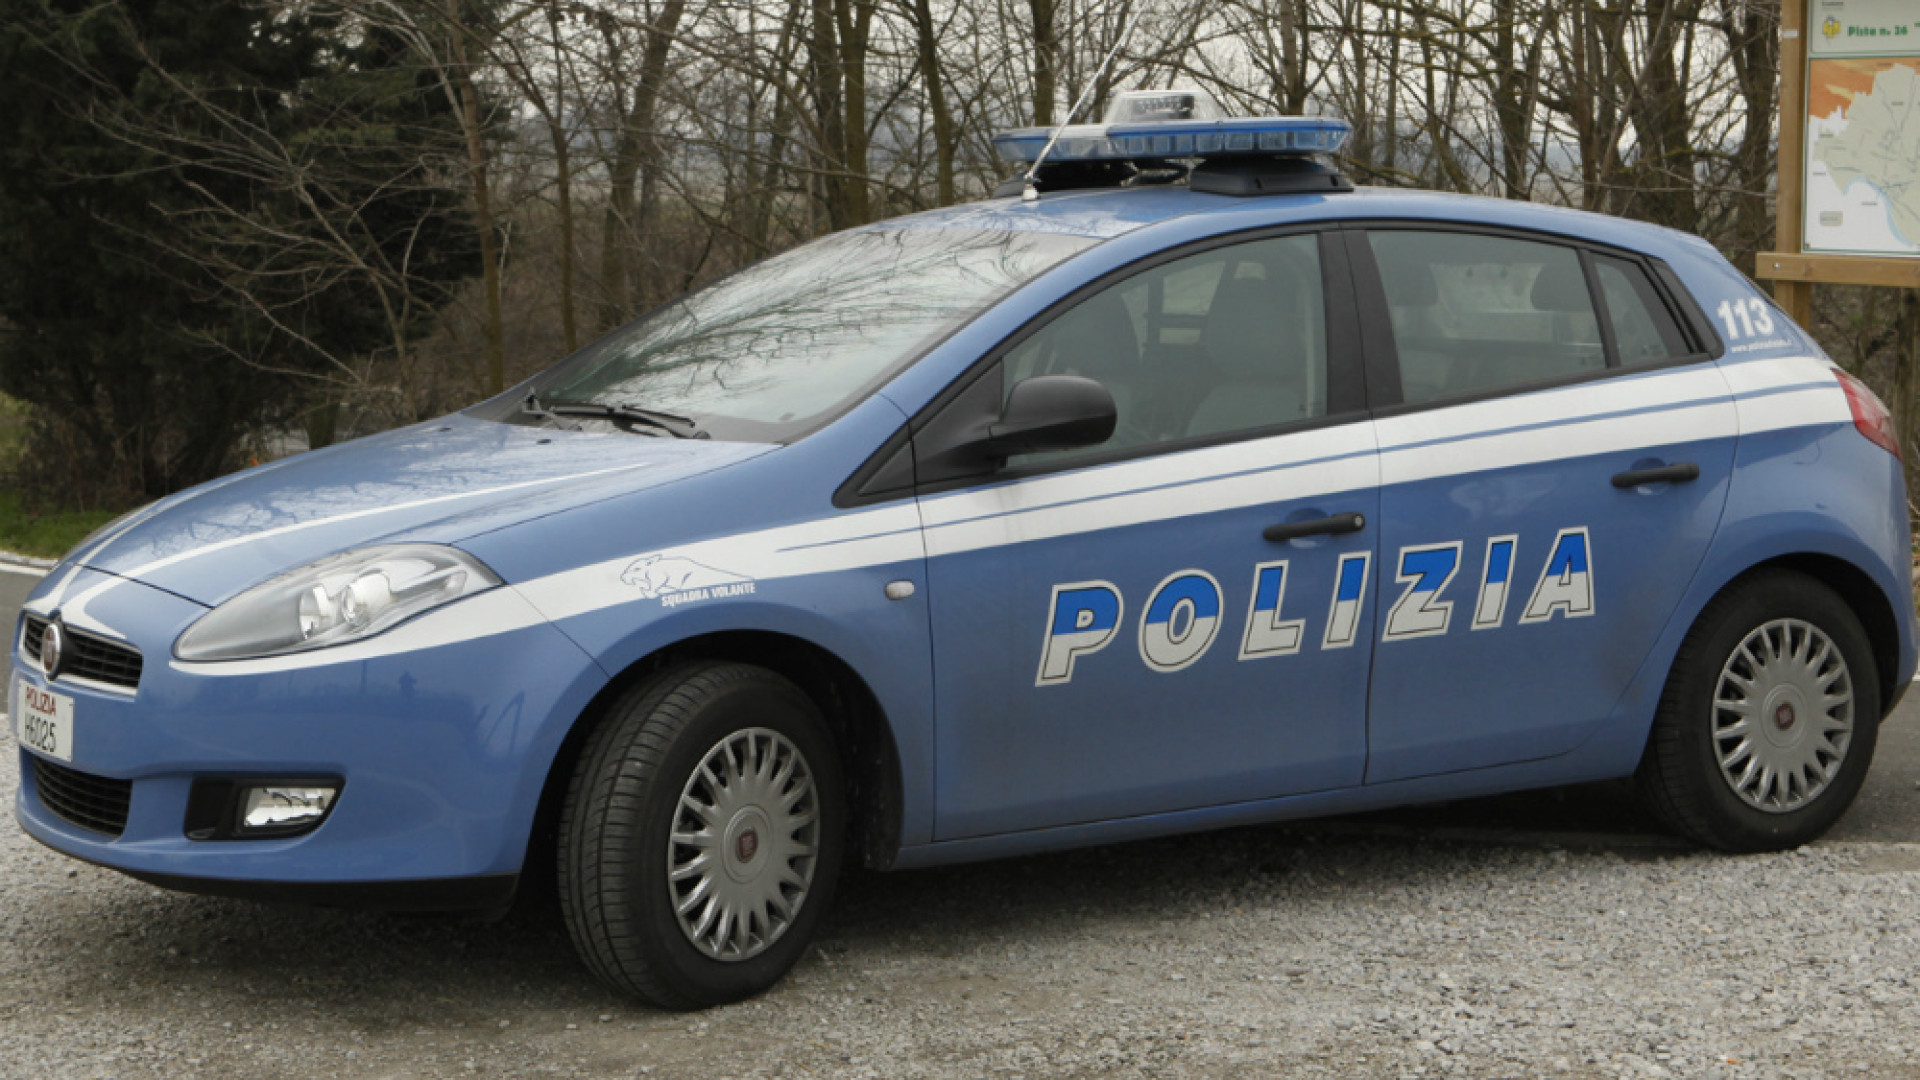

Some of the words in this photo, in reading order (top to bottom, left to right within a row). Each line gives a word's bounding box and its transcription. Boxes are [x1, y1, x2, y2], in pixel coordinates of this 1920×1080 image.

[1717, 297, 1774, 339] 113
[661, 589, 709, 608] SQUADRA
[712, 582, 756, 598] VOLANTE
[1035, 526, 1595, 686] POLIZIA
[26, 686, 57, 715] POLIZIA
[25, 713, 57, 752] H6025
